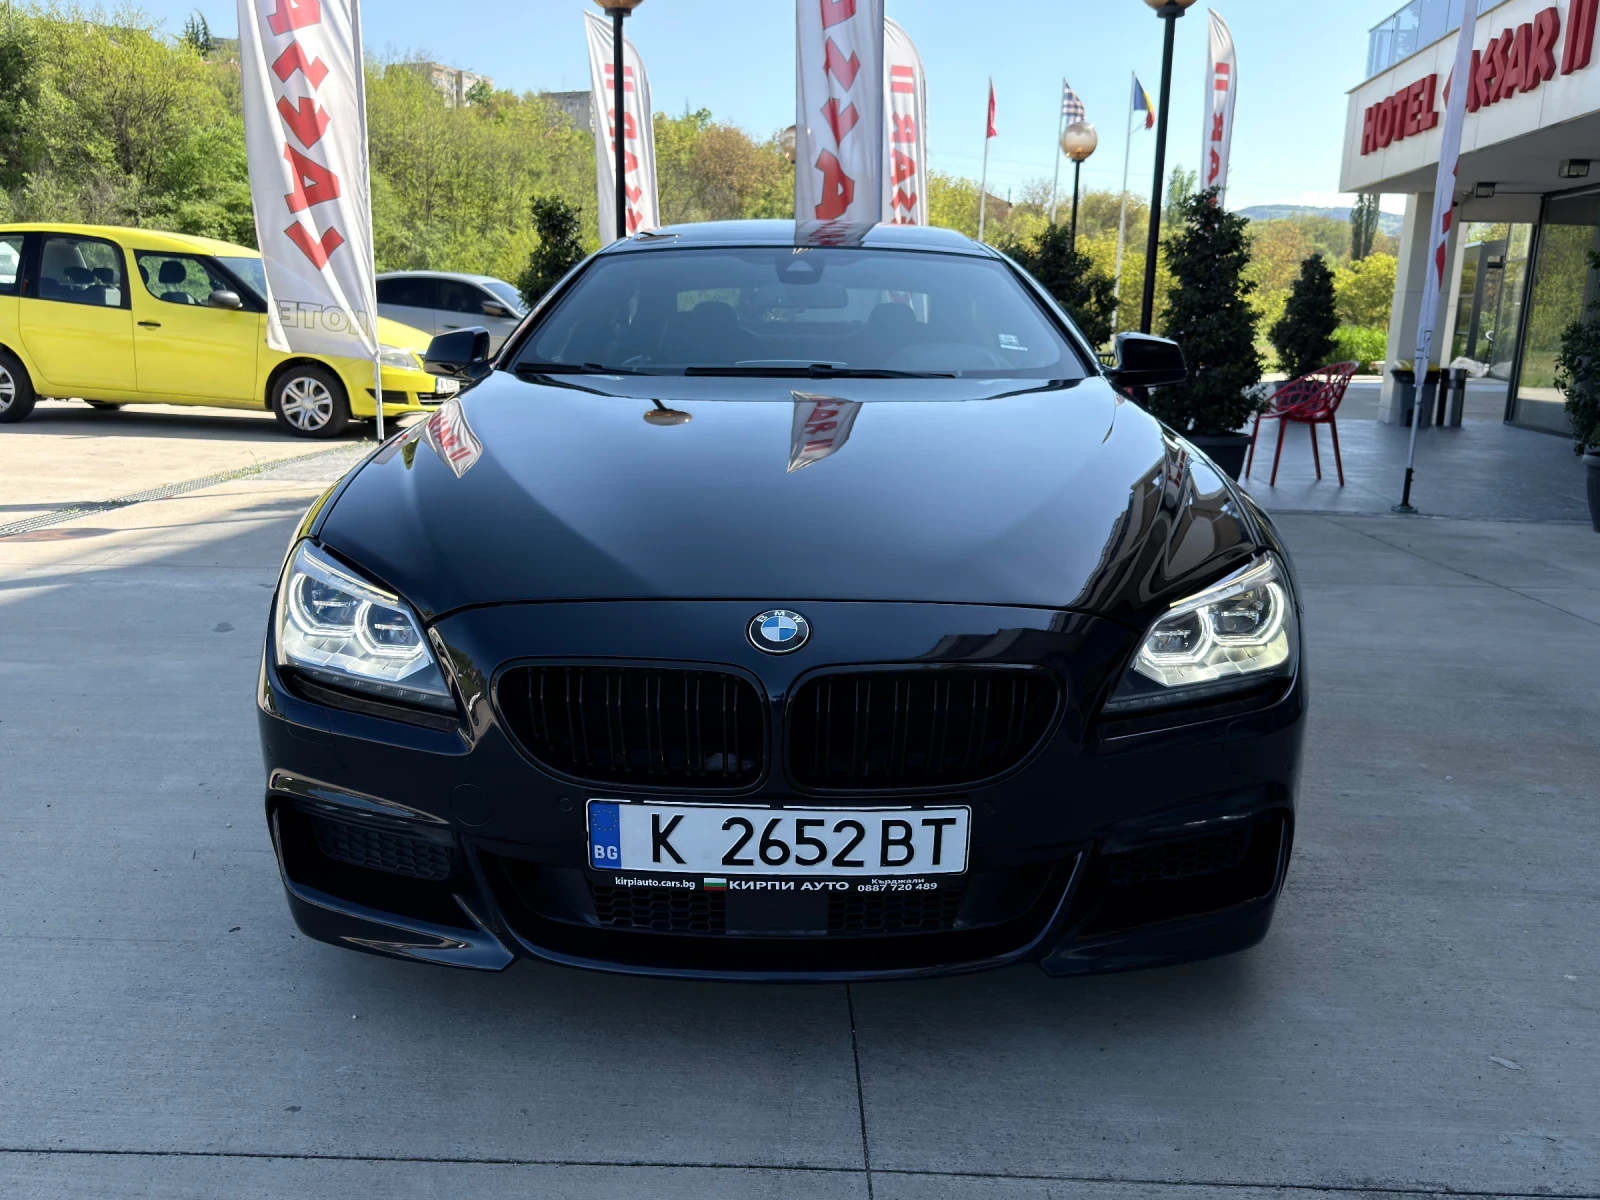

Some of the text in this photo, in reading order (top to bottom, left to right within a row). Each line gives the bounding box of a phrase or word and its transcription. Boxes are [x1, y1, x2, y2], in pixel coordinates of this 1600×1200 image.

[1361, 73, 1439, 156] HOTEL
[1442, 7, 1561, 113] ESAR
[756, 610, 803, 623] BMW
[593, 845, 618, 860] BG
[650, 813, 687, 865] K
[615, 876, 696, 890] kirpiauto.cars.bg
[729, 880, 850, 891] КИРПИ АУТО
[857, 882, 938, 892] 0887 720 489
